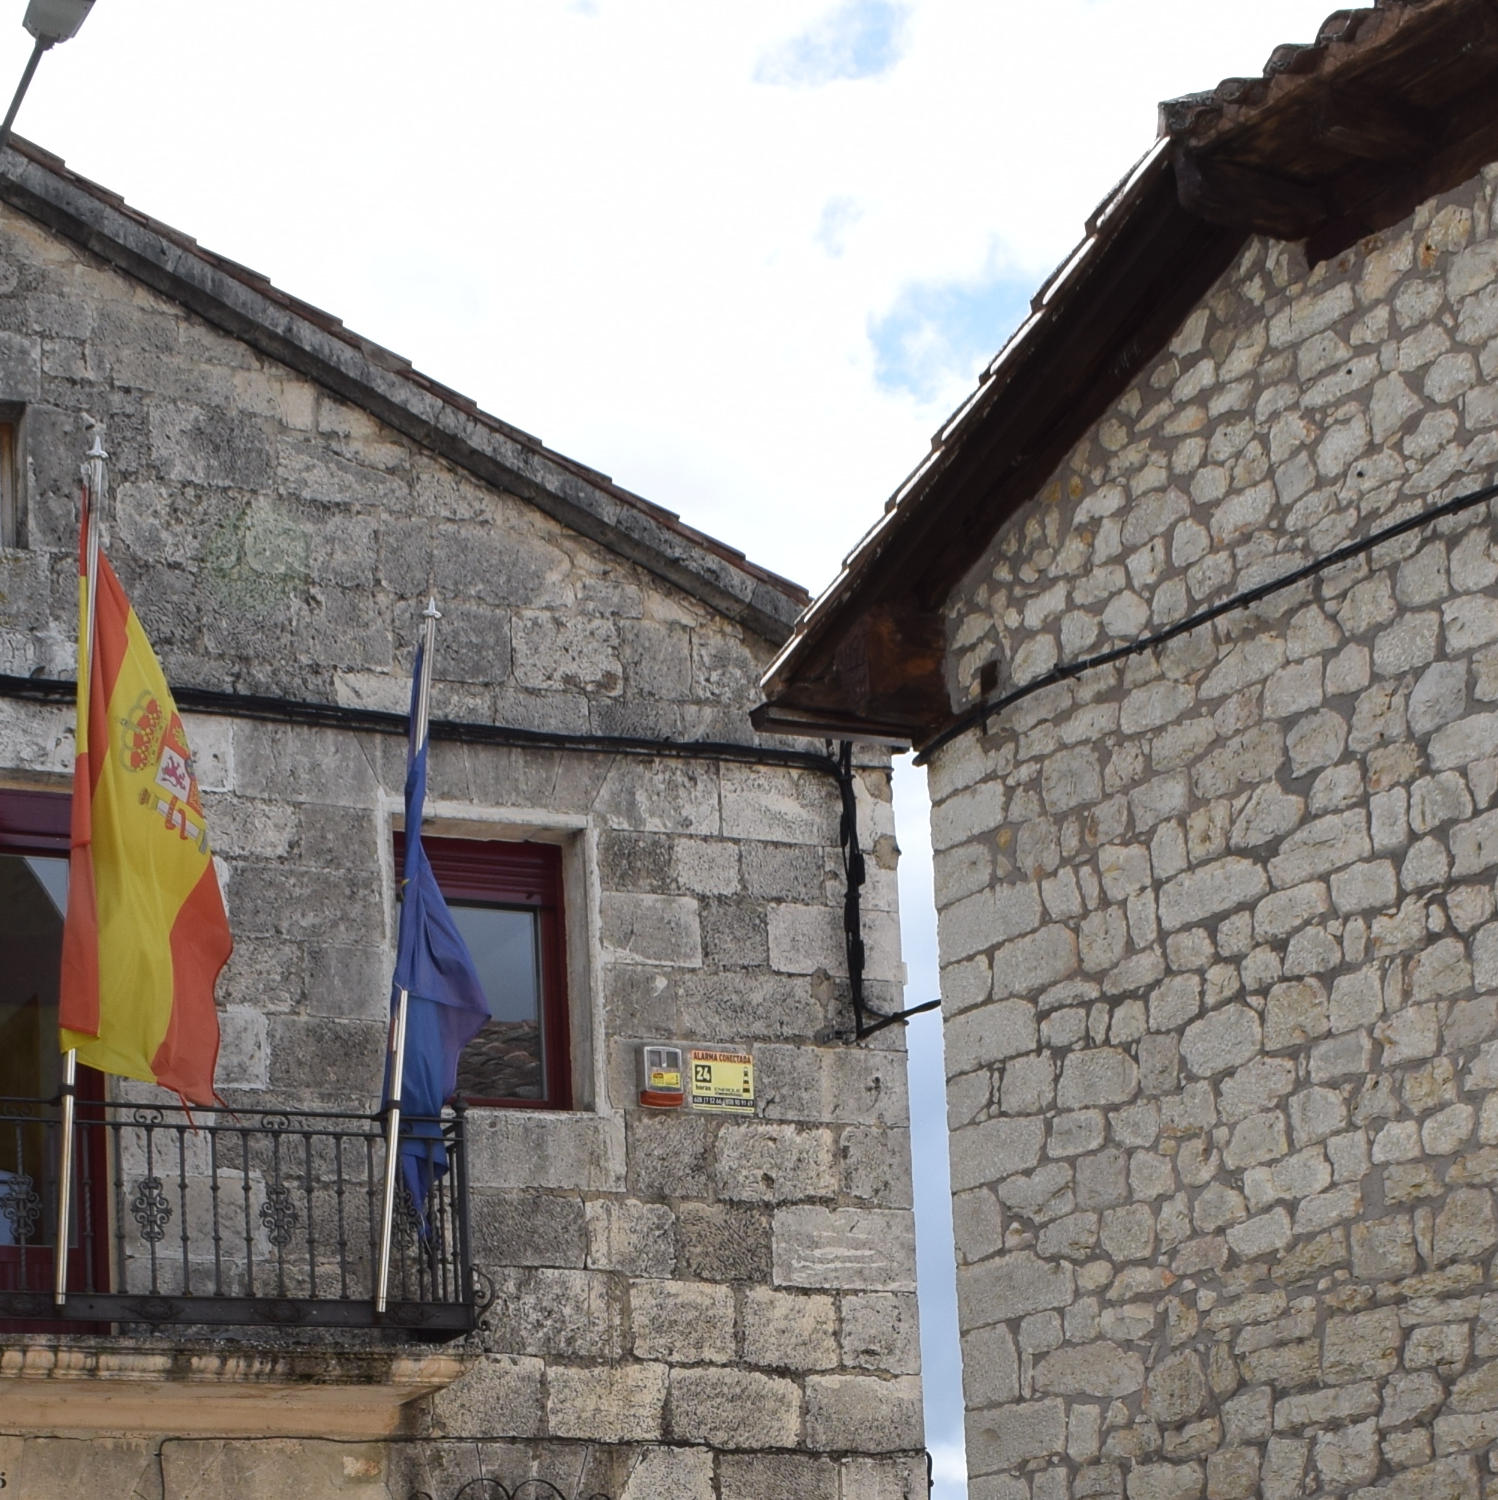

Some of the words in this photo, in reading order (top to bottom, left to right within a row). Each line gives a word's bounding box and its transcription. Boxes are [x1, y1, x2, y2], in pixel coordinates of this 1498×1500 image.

[694, 1051, 718, 1061] ALARMA
[719, 1053, 751, 1064] CONECTADA
[696, 1066, 711, 1081] 24
